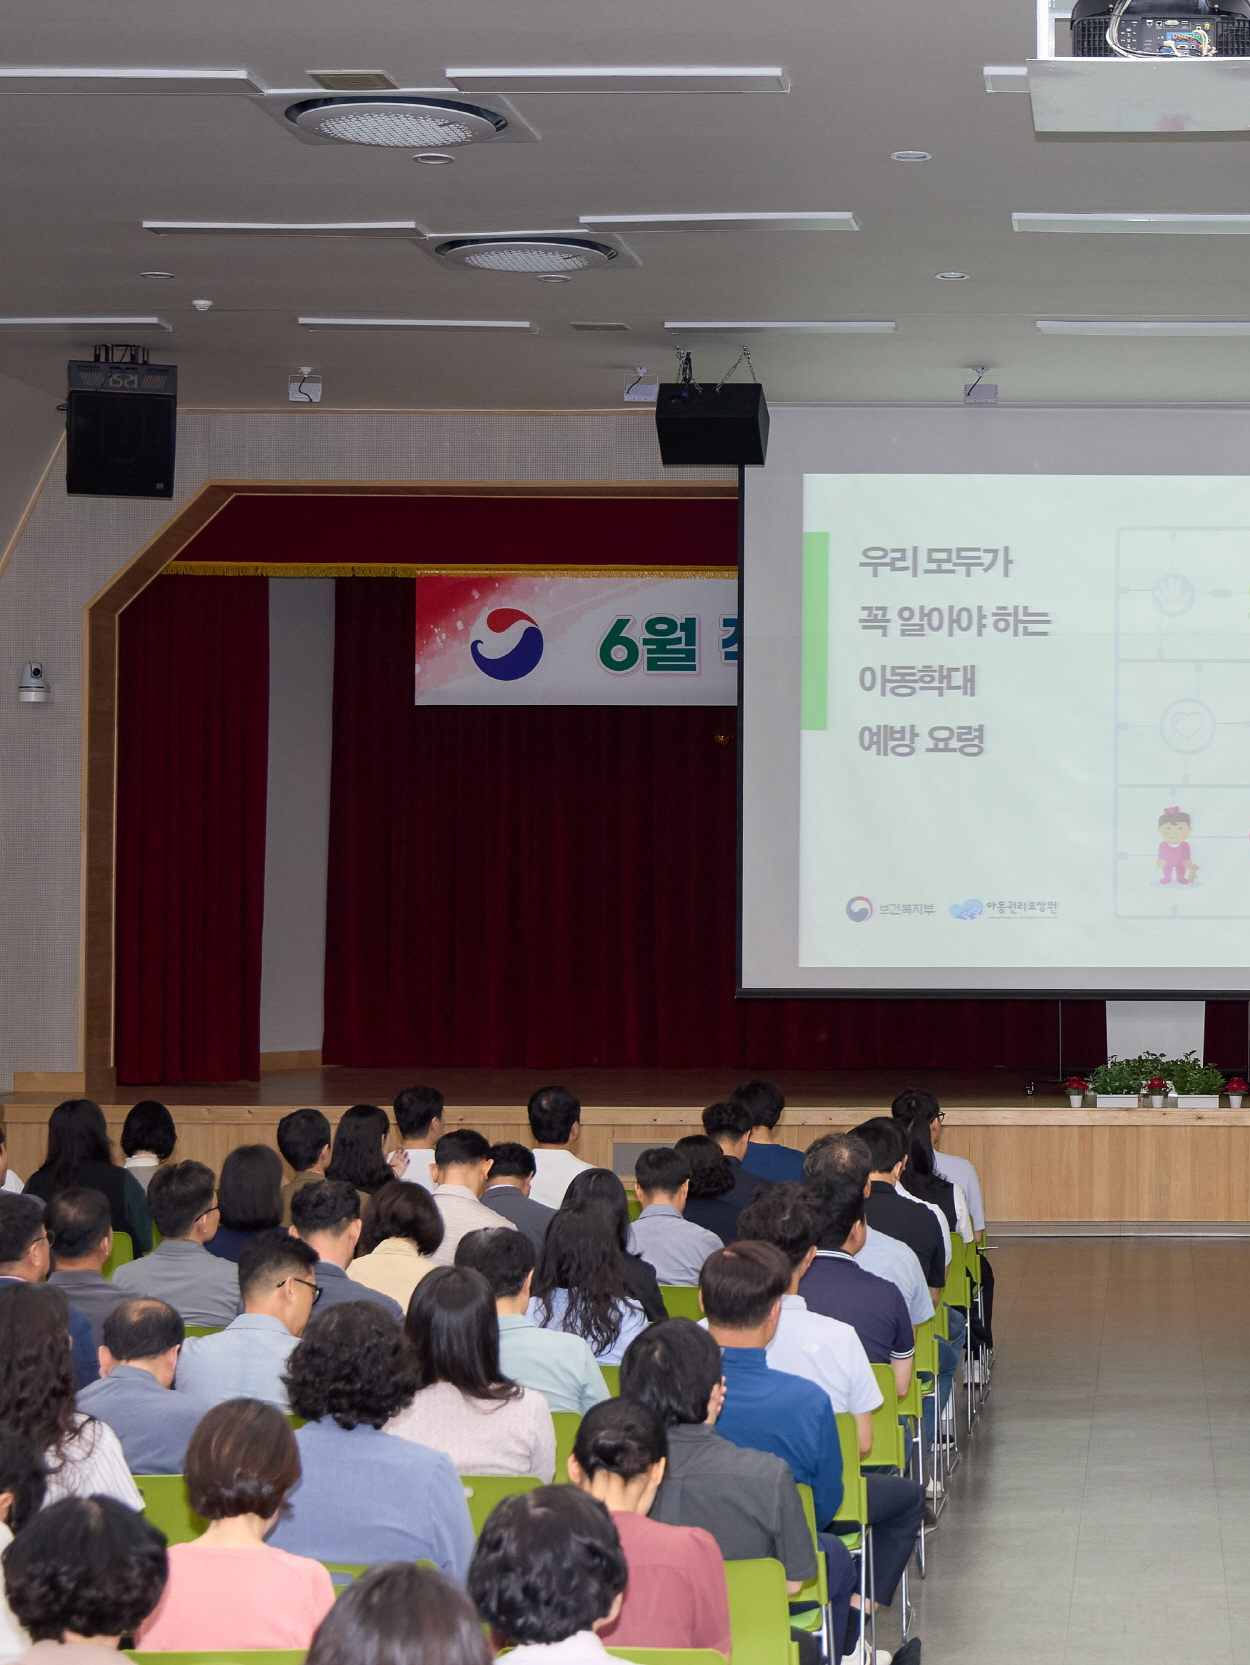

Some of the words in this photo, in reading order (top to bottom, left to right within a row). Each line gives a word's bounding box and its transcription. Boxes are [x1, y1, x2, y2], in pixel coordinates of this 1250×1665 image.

[858, 545, 919, 578] 우리
[923, 545, 1014, 578] 모두가
[858, 605, 892, 638] 꼭
[897, 605, 987, 638] 알아야
[991, 605, 1052, 638] 하는
[598, 615, 698, 673] 6월
[858, 724, 920, 757] 예방
[924, 724, 985, 757] 요령
[878, 903, 936, 915] 보건복지부
[986, 901, 1058, 915] 아동권리보장원
